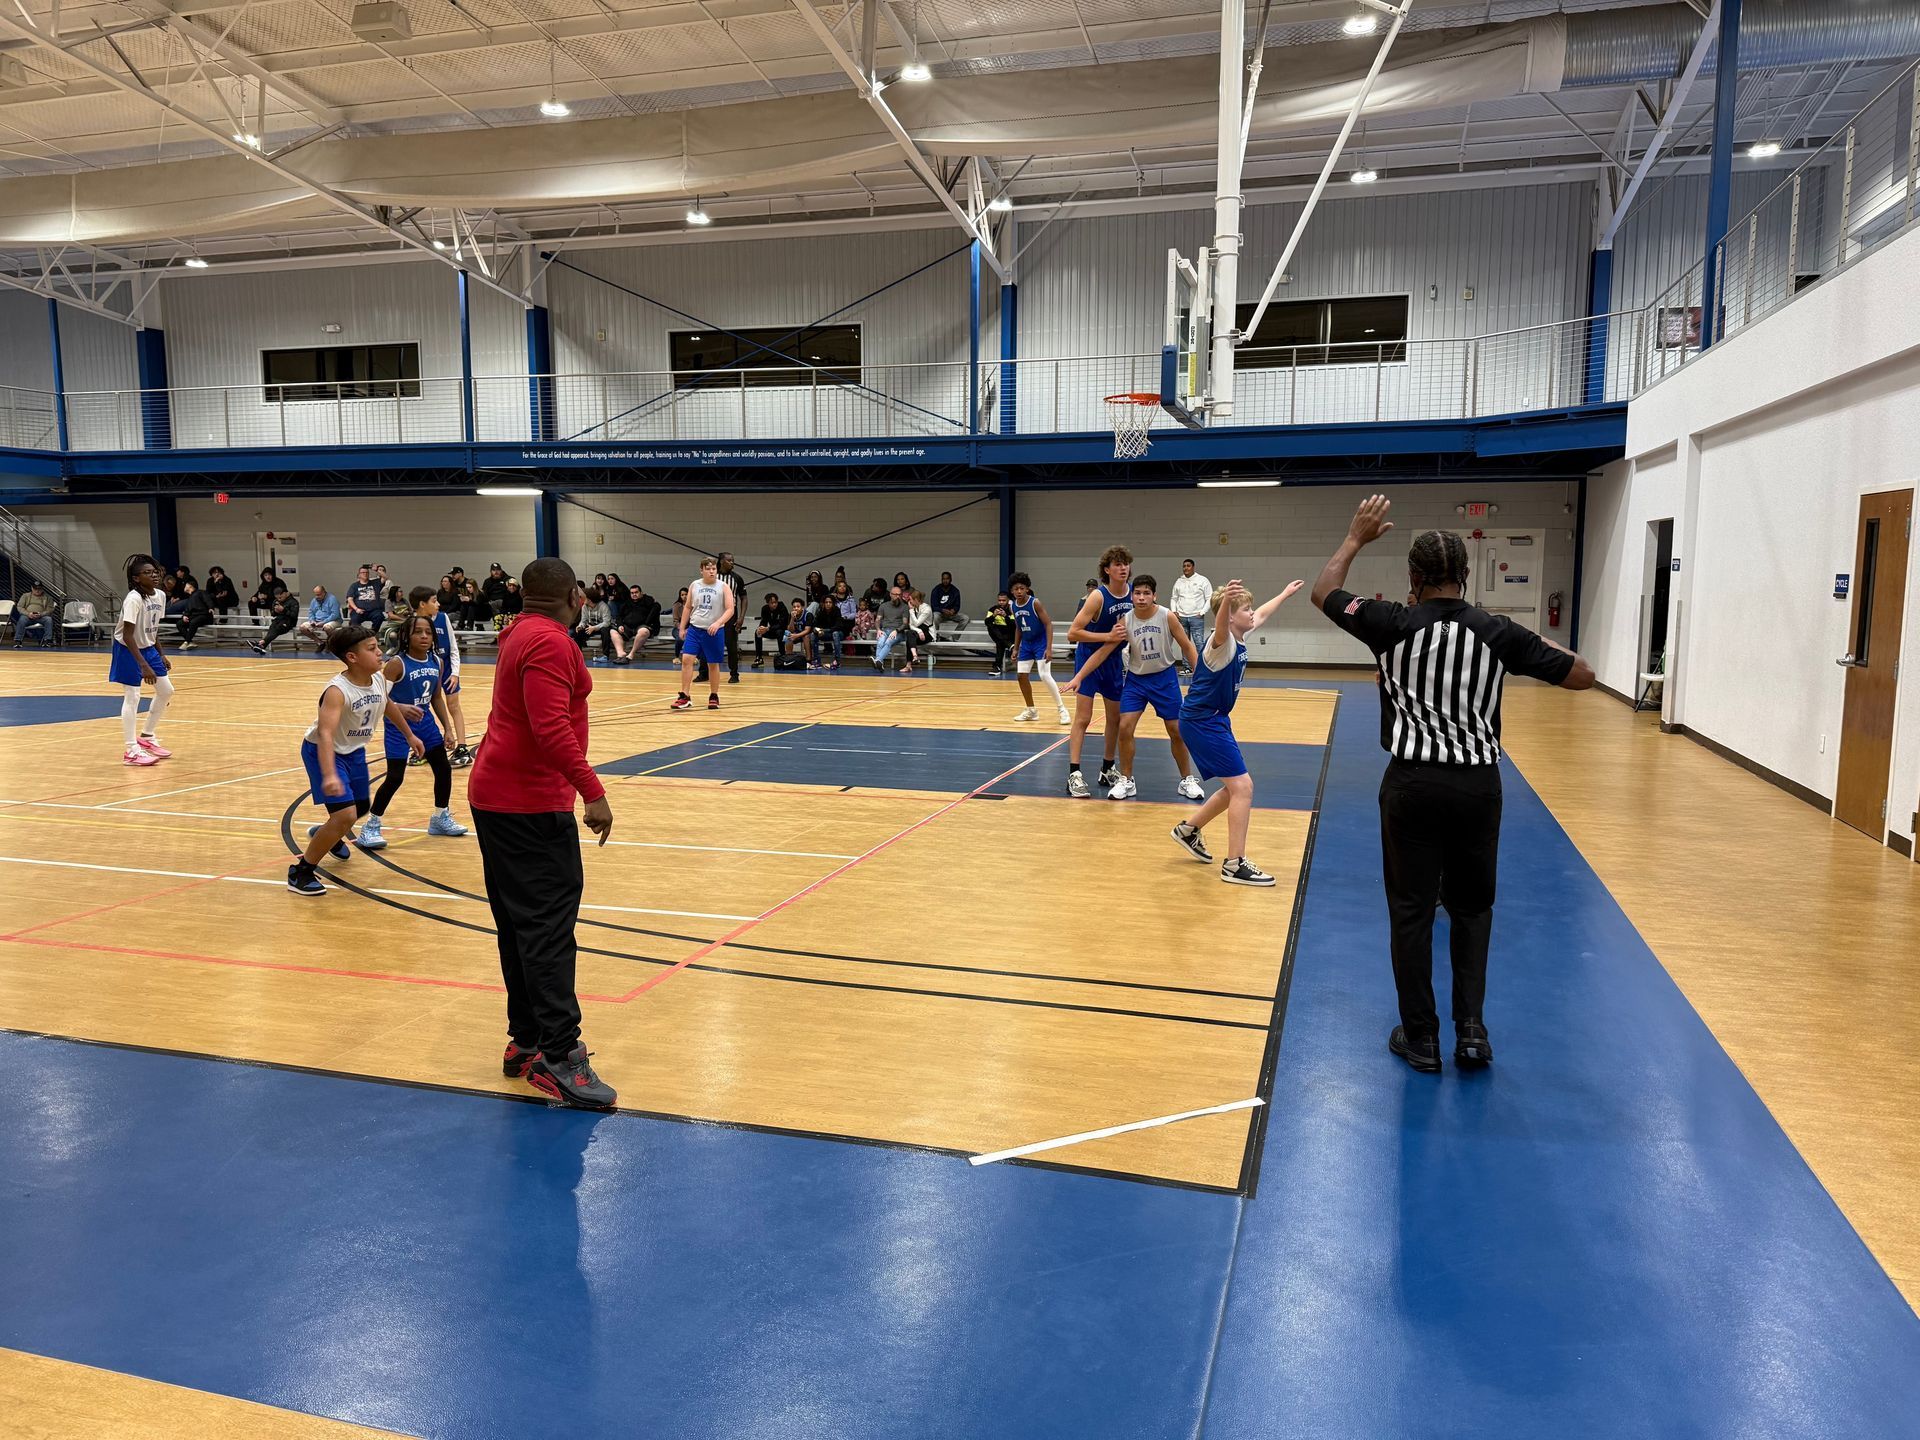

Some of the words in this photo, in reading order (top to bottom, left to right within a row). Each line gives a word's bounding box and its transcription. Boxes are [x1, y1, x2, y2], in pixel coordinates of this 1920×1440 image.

[218, 494, 229, 504] EXIT
[1469, 504, 1486, 516] EXIT
[1836, 580, 1848, 588] CYCLE
[703, 594, 711, 604] 13
[1134, 627, 1142, 638] FBC
[1142, 626, 1162, 634] SPORTS
[1142, 637, 1154, 652] 11
[409, 670, 420, 680] FBC
[422, 680, 432, 698] 2
[352, 697, 364, 710] FBC
[362, 710, 371, 726] 3
